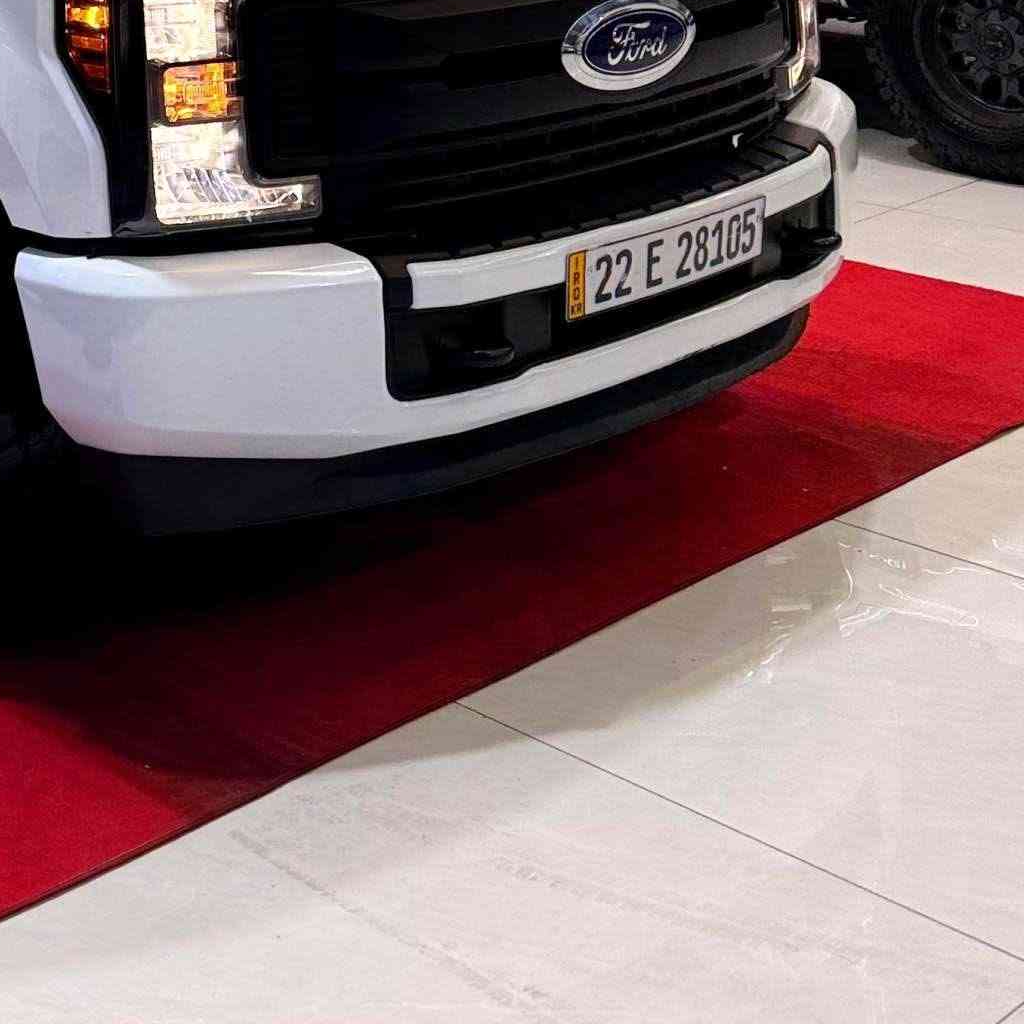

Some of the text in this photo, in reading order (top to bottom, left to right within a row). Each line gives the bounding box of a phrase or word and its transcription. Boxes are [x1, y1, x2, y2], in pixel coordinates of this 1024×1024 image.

[607, 20, 668, 66] Ford
[594, 207, 756, 304] 22 E 28105
